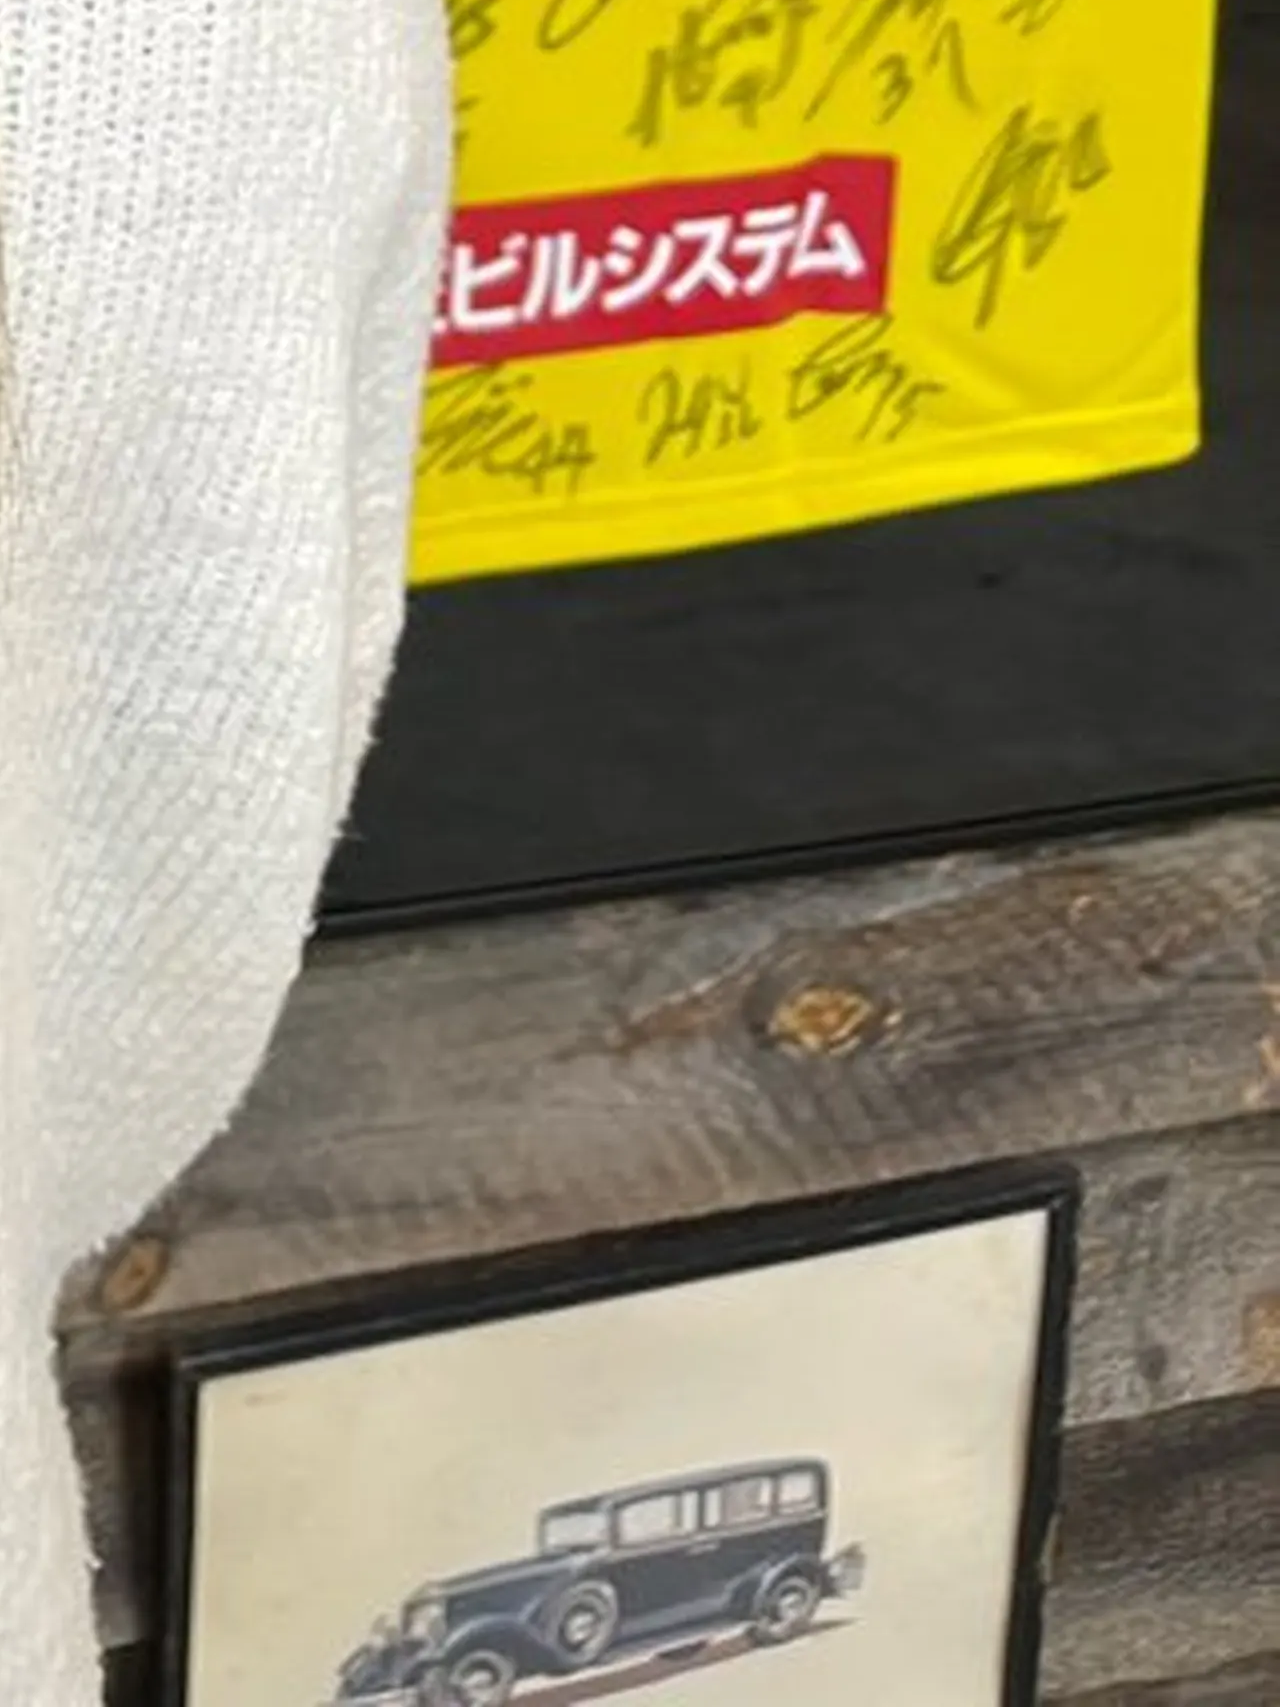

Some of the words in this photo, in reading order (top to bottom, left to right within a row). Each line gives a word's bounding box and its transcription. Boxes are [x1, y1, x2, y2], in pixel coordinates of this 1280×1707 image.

[435, 192, 864, 333] ビルシステム
